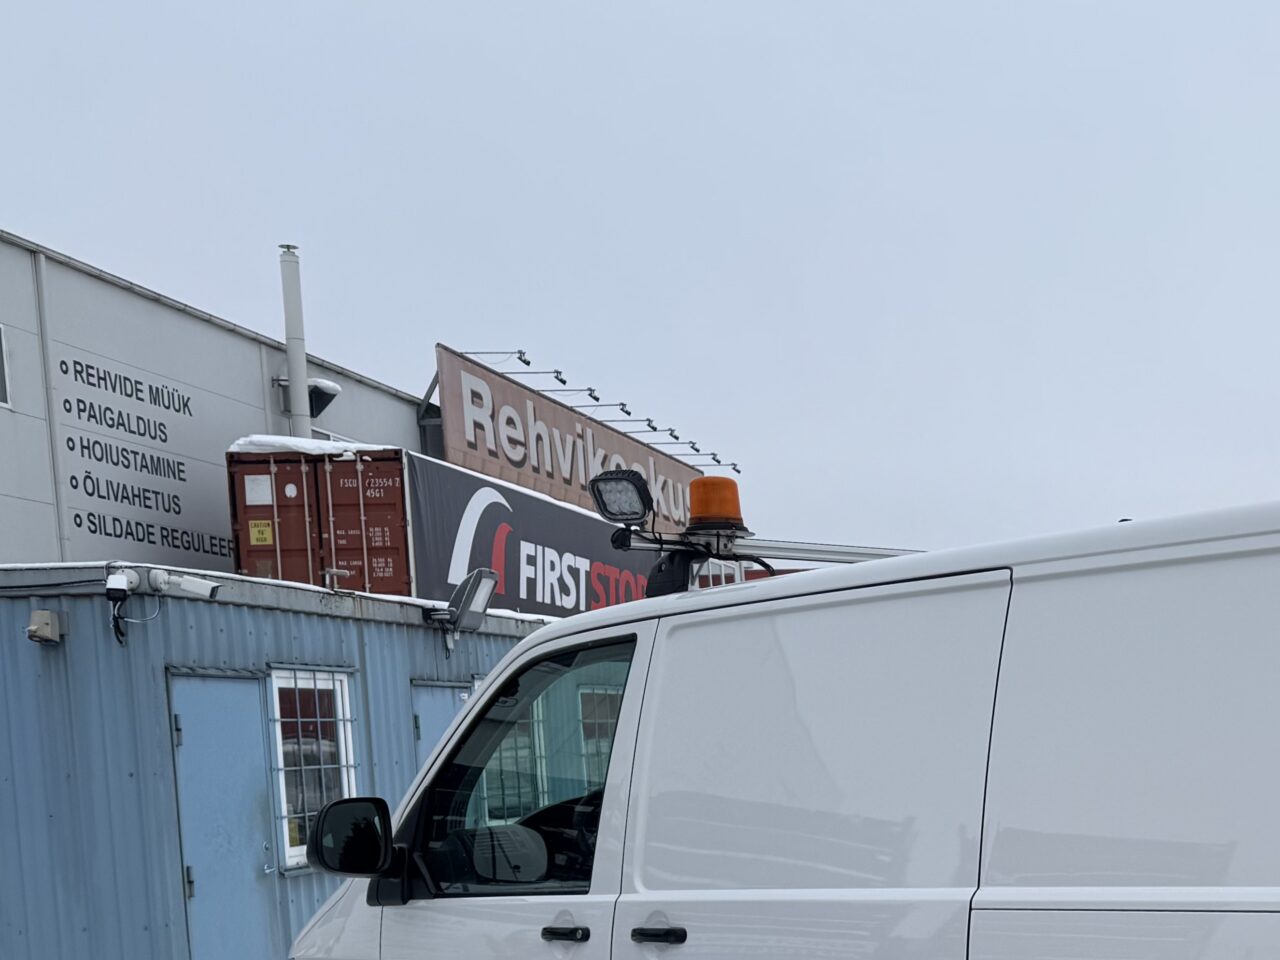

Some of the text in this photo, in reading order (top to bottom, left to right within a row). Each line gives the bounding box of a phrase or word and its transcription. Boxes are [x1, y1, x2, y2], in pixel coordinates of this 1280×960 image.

[73, 359, 193, 417] REHVIDE MÜÜK
[76, 398, 168, 443] PAIGALDUS
[79, 436, 187, 482] HOIUSTAMINE
[83, 470, 181, 515] ÕLIVAHETUS
[87, 512, 157, 545] SILDADE
